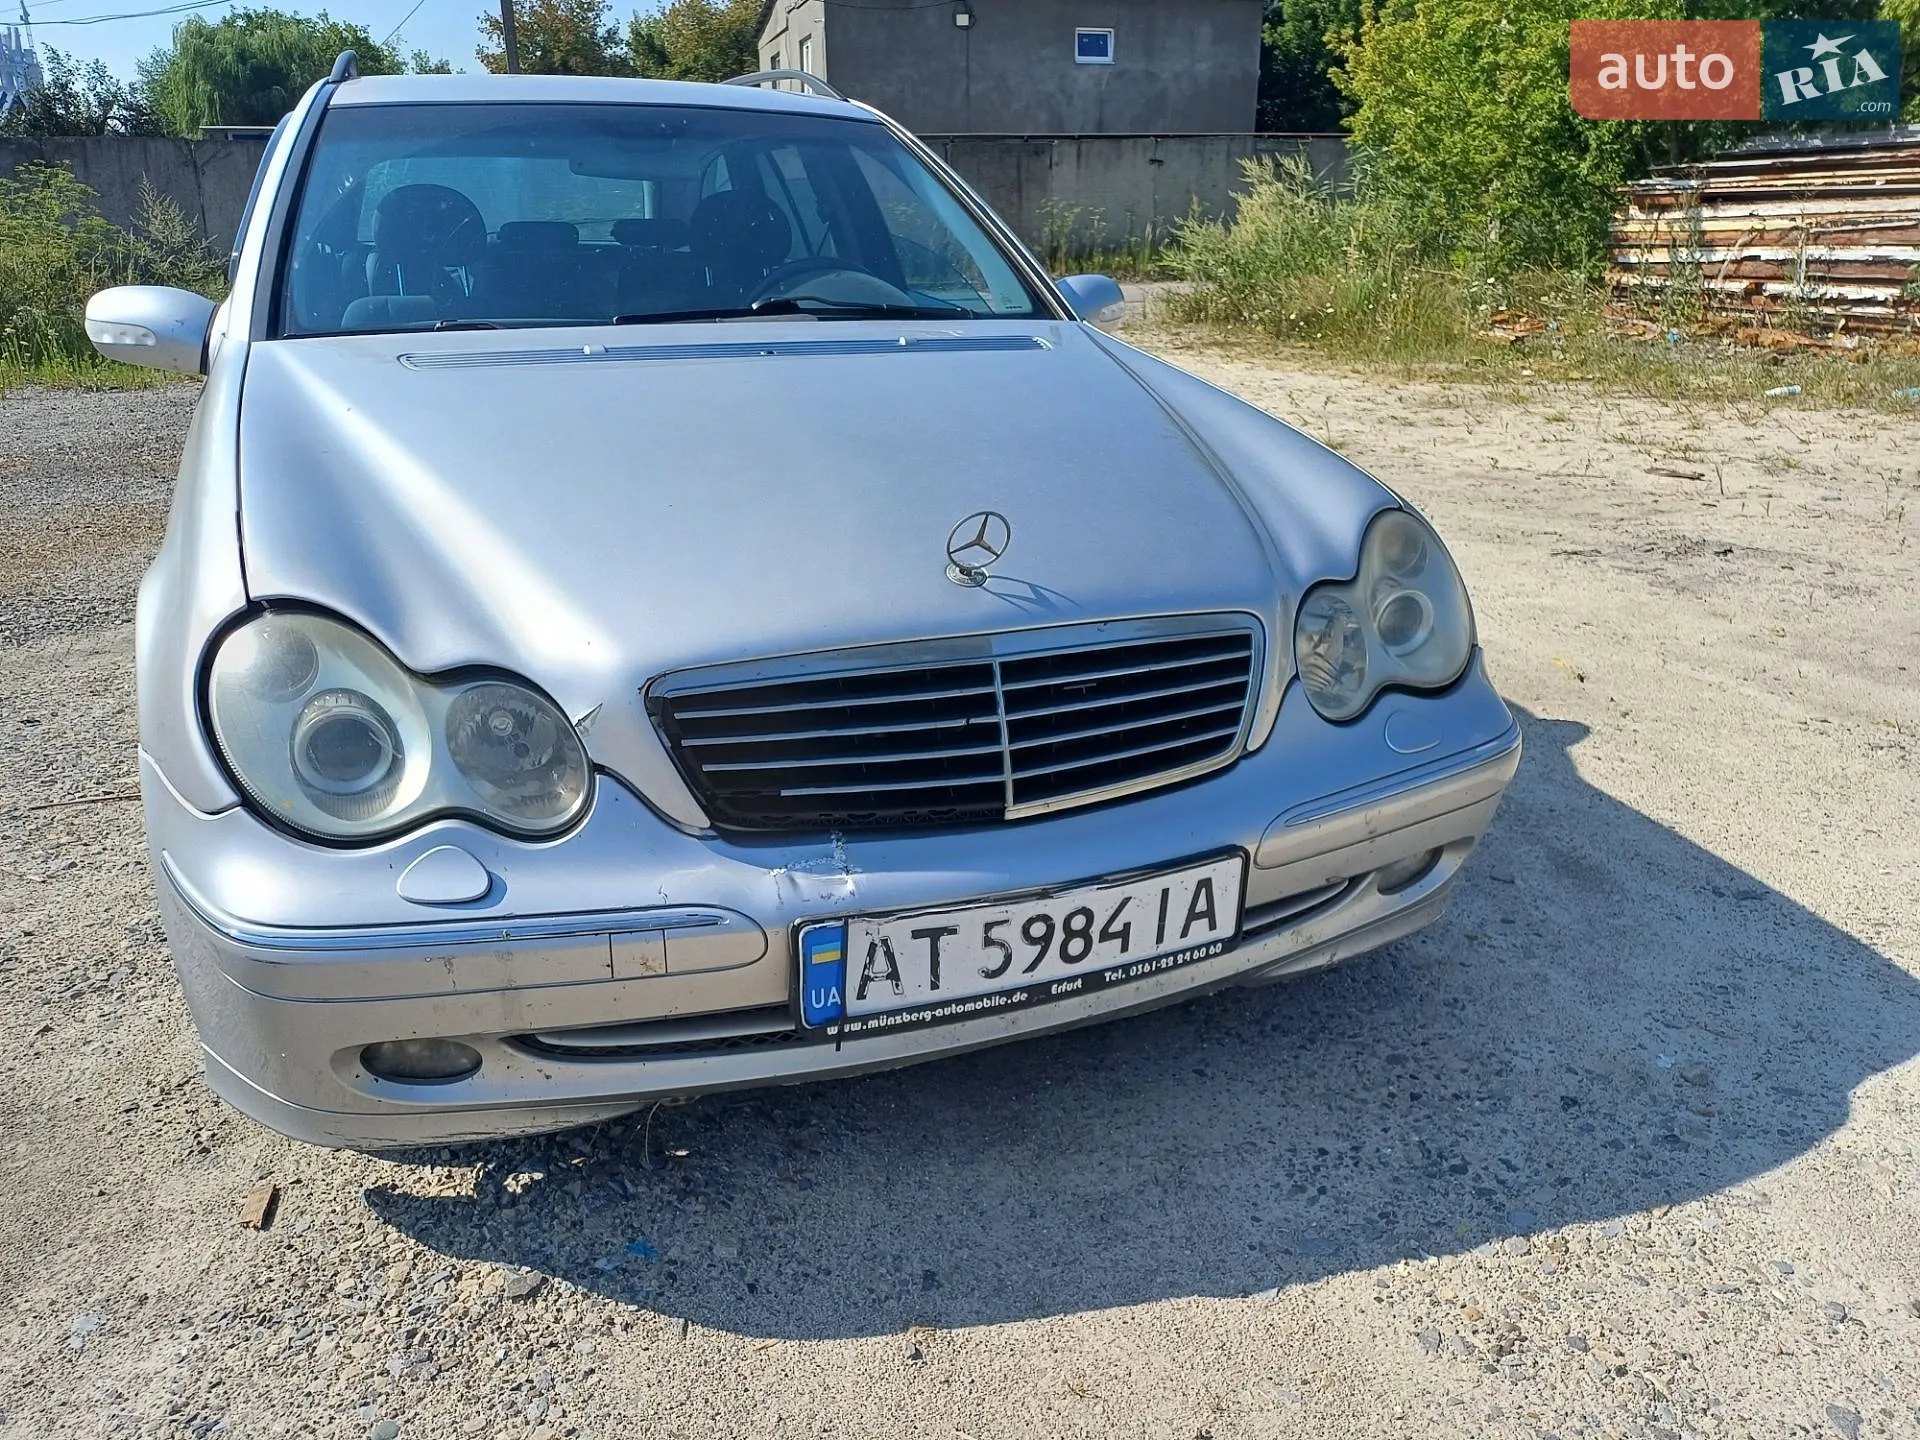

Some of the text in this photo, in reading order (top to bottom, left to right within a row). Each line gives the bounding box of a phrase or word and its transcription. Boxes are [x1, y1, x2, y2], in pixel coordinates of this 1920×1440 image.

[856, 877, 1217, 1001] AT 5984 IA
[1051, 978, 1083, 995] Erfurt
[1104, 968, 1126, 983] Tel.
[811, 990, 841, 1009] UA
